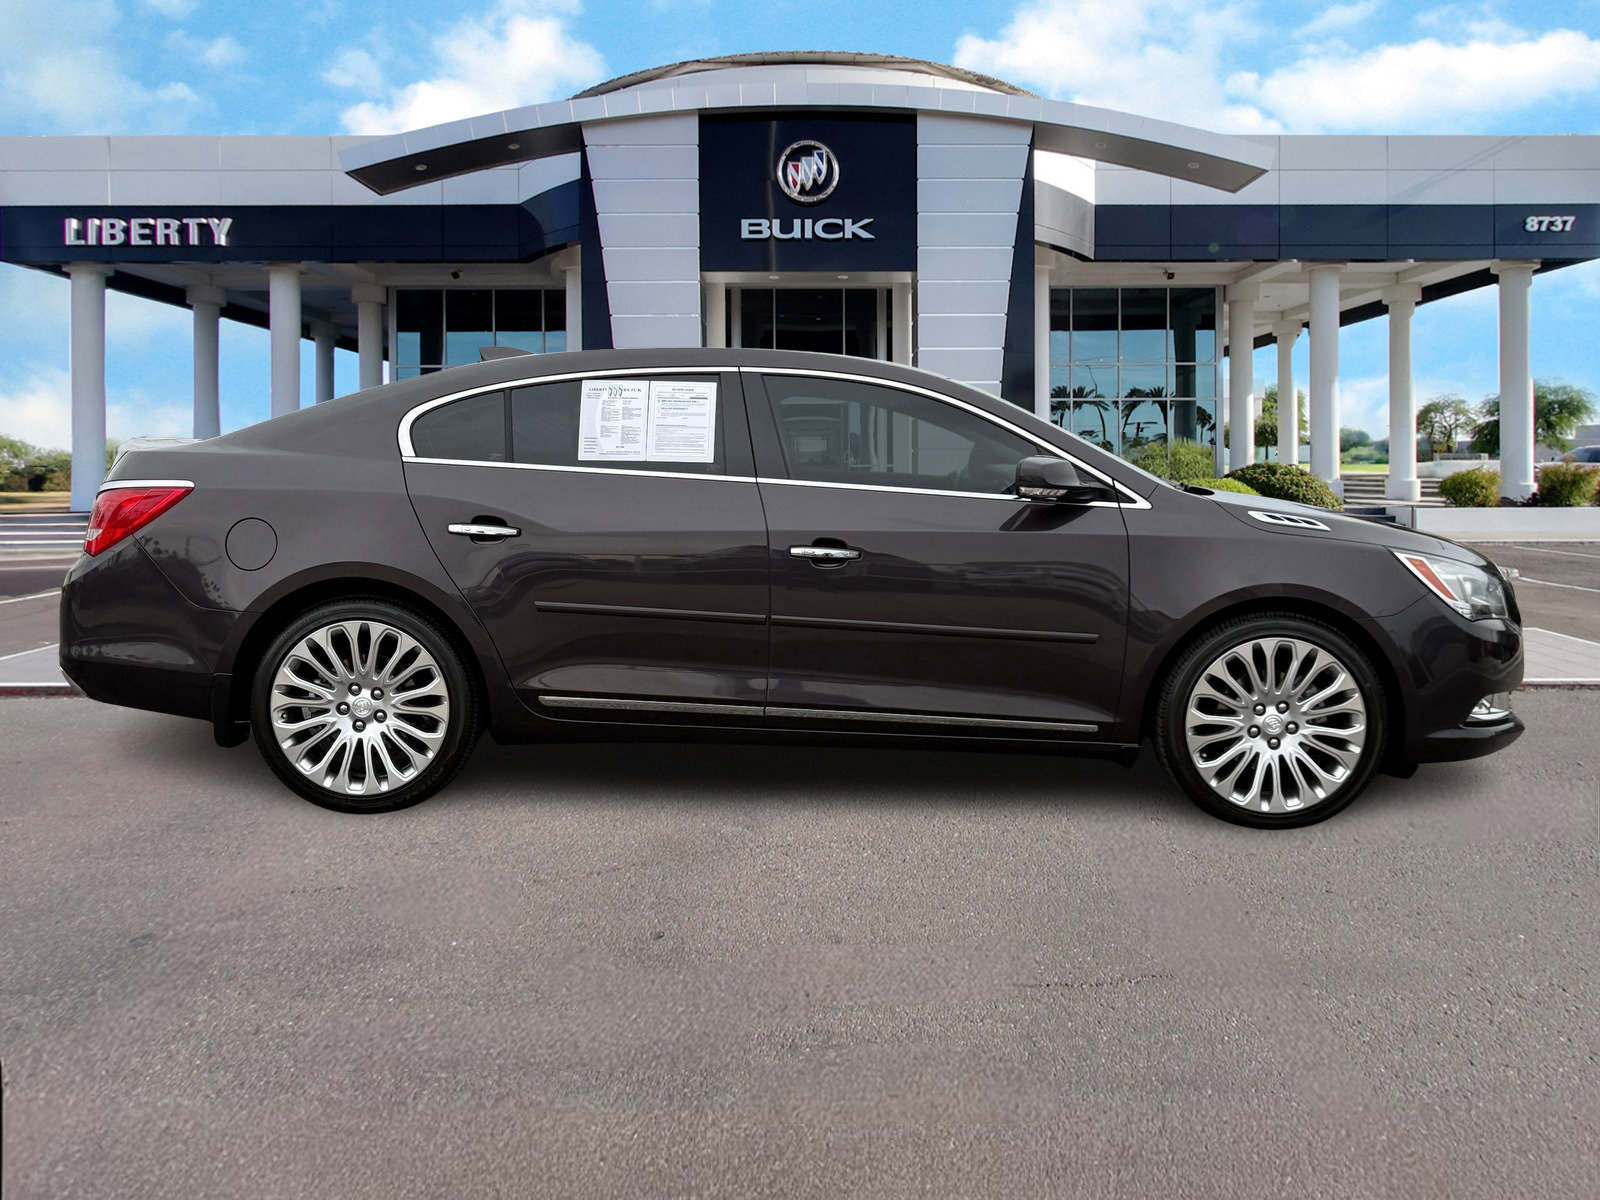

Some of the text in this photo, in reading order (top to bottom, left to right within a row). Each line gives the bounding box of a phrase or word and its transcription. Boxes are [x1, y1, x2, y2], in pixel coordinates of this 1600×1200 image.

[64, 217, 233, 246] LIBERTY
[740, 218, 876, 239] BUICK
[1524, 215, 1576, 232] 8737
